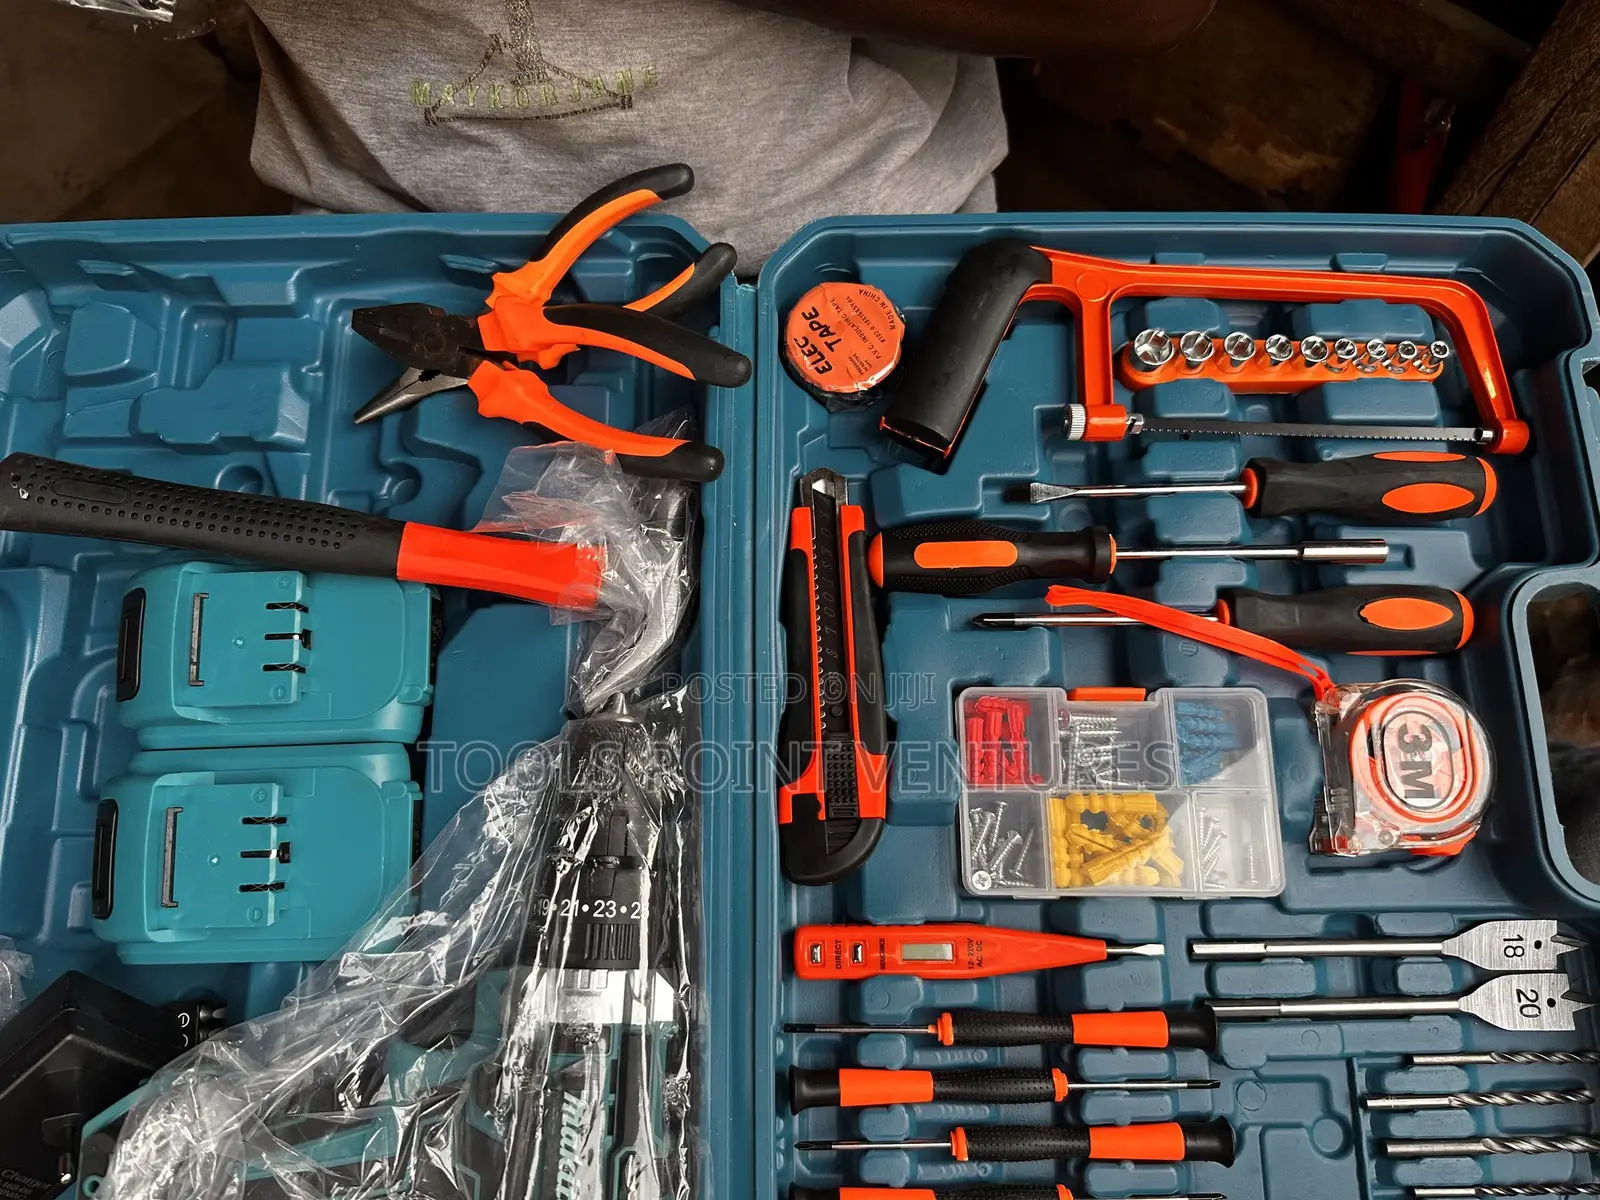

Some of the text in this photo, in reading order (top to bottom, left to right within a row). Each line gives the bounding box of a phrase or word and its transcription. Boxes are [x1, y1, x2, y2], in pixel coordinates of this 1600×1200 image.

[829, 297, 843, 314] TAPE
[858, 288, 896, 331] MADE IN CHINA
[801, 306, 842, 353] TAPE
[841, 313, 869, 344] INSULATING
[793, 336, 833, 375] ELEC
[1398, 723, 1436, 799] 3M
[592, 900, 618, 918] 23
[834, 939, 843, 970] DIRECT
[966, 937, 975, 970] 12-220V
[1503, 934, 1525, 958] 18
[1516, 988, 1541, 1019] 20
